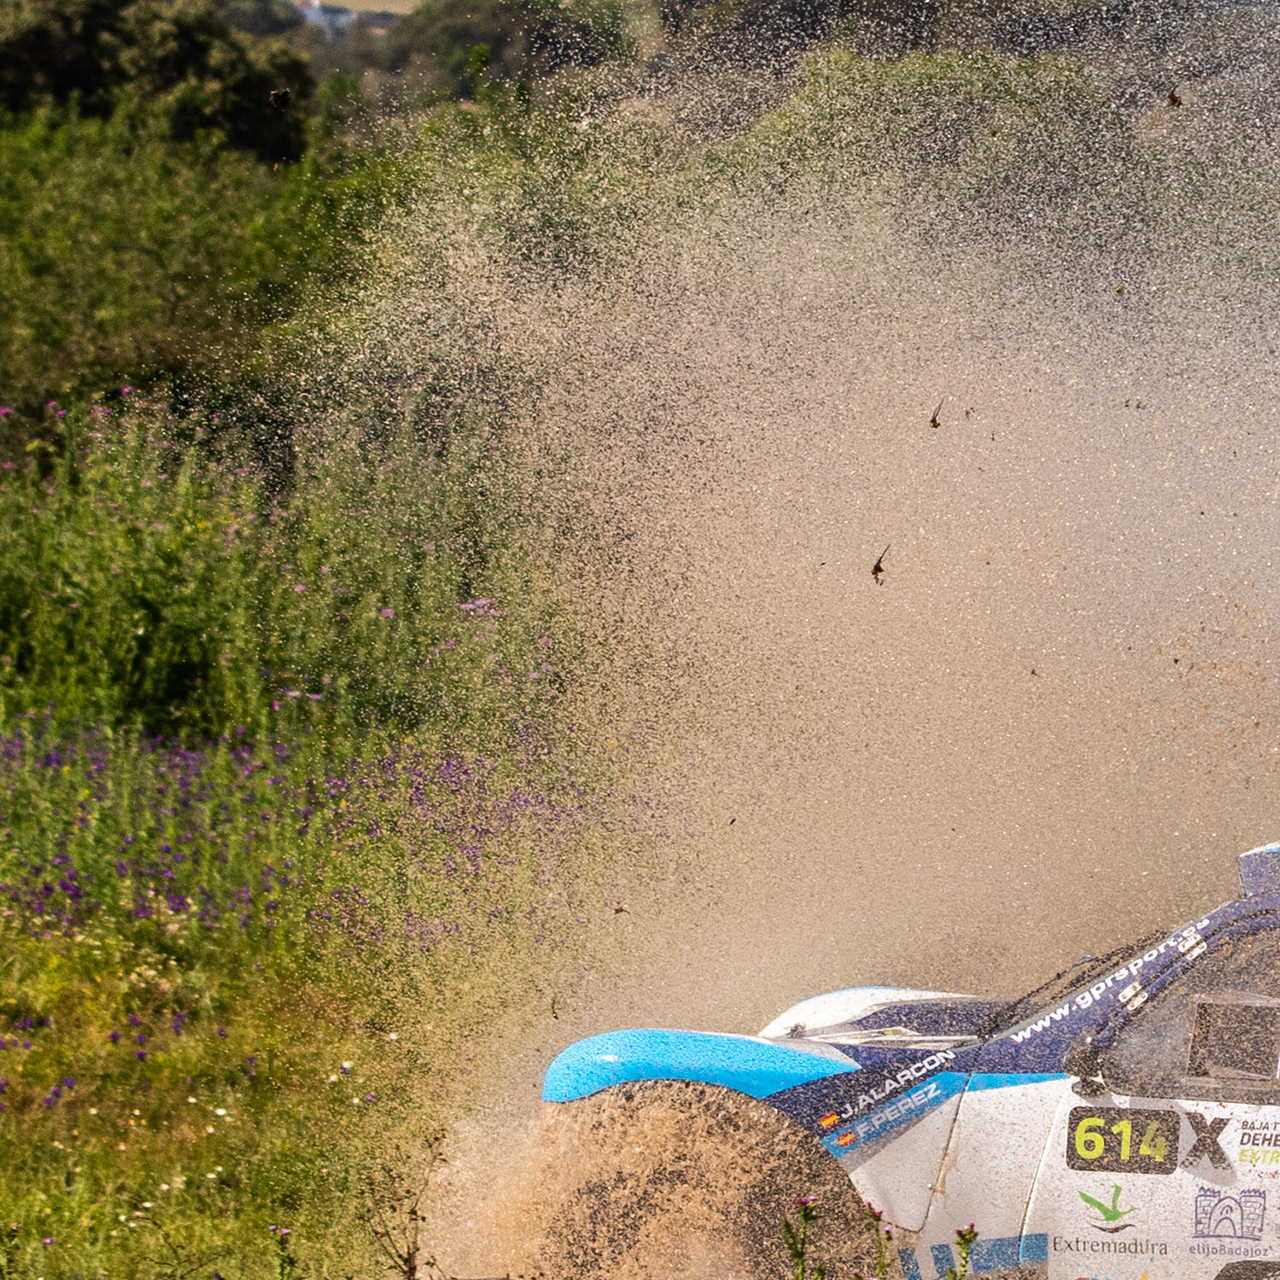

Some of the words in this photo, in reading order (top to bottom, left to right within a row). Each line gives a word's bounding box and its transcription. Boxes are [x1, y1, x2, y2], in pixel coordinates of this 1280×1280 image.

[1010, 918, 1211, 1044] www.gprsport.es
[856, 1082, 942, 1138] F.PEREZ
[1241, 1120, 1270, 1131] BAJA
[1074, 1117, 1170, 1163] 614
[1053, 1236, 1168, 1256] Extremadura
[1189, 1243, 1269, 1257] elijoBadajoz
